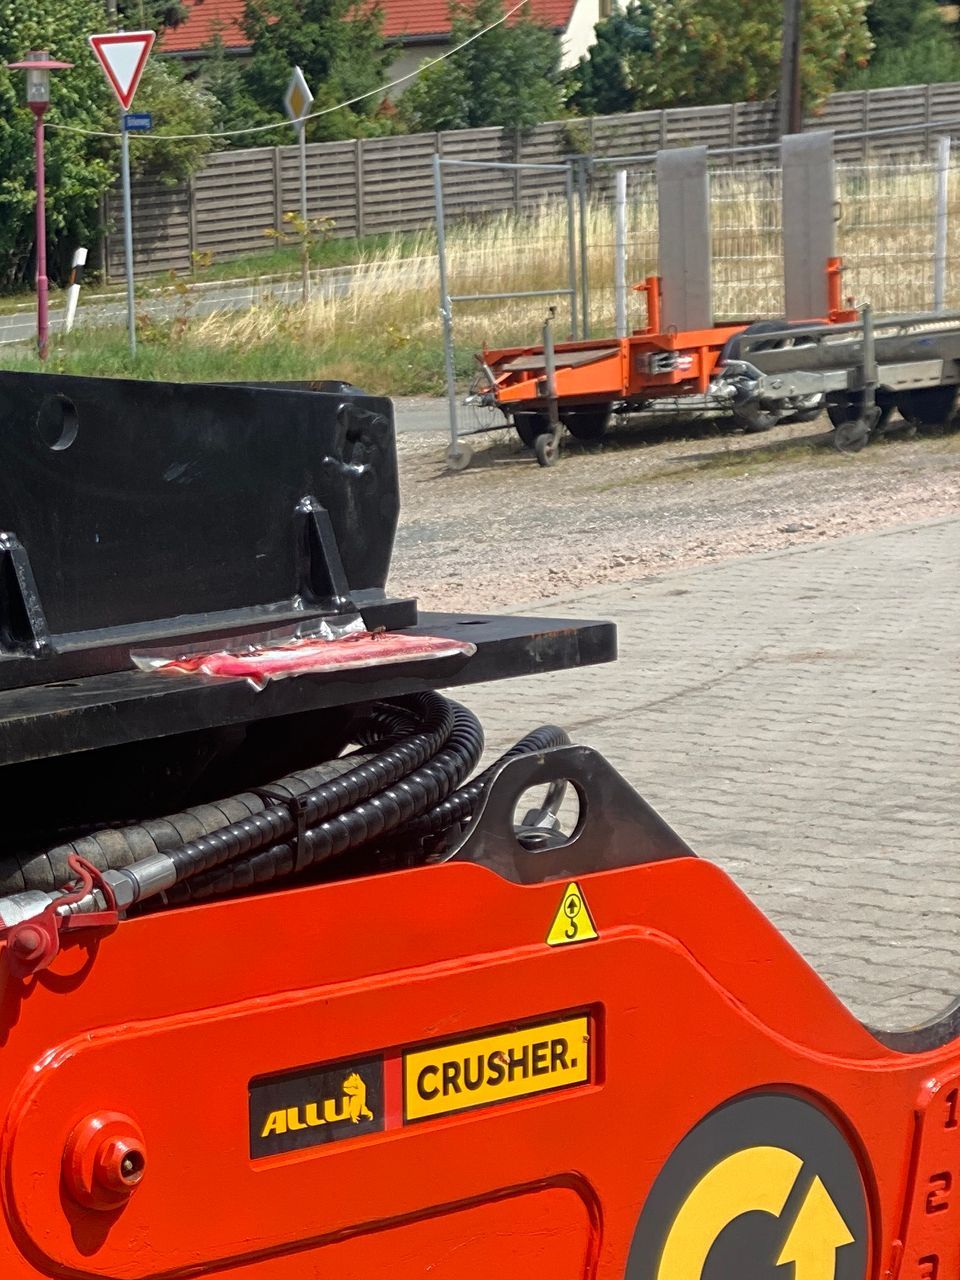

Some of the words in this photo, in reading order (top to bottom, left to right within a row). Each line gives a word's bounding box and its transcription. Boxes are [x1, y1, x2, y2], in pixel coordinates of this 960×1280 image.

[261, 1096, 353, 1138] ALLU
[417, 1037, 577, 1101] CRUSHER.
[944, 1088, 959, 1129] 1
[925, 1171, 952, 1215] 2
